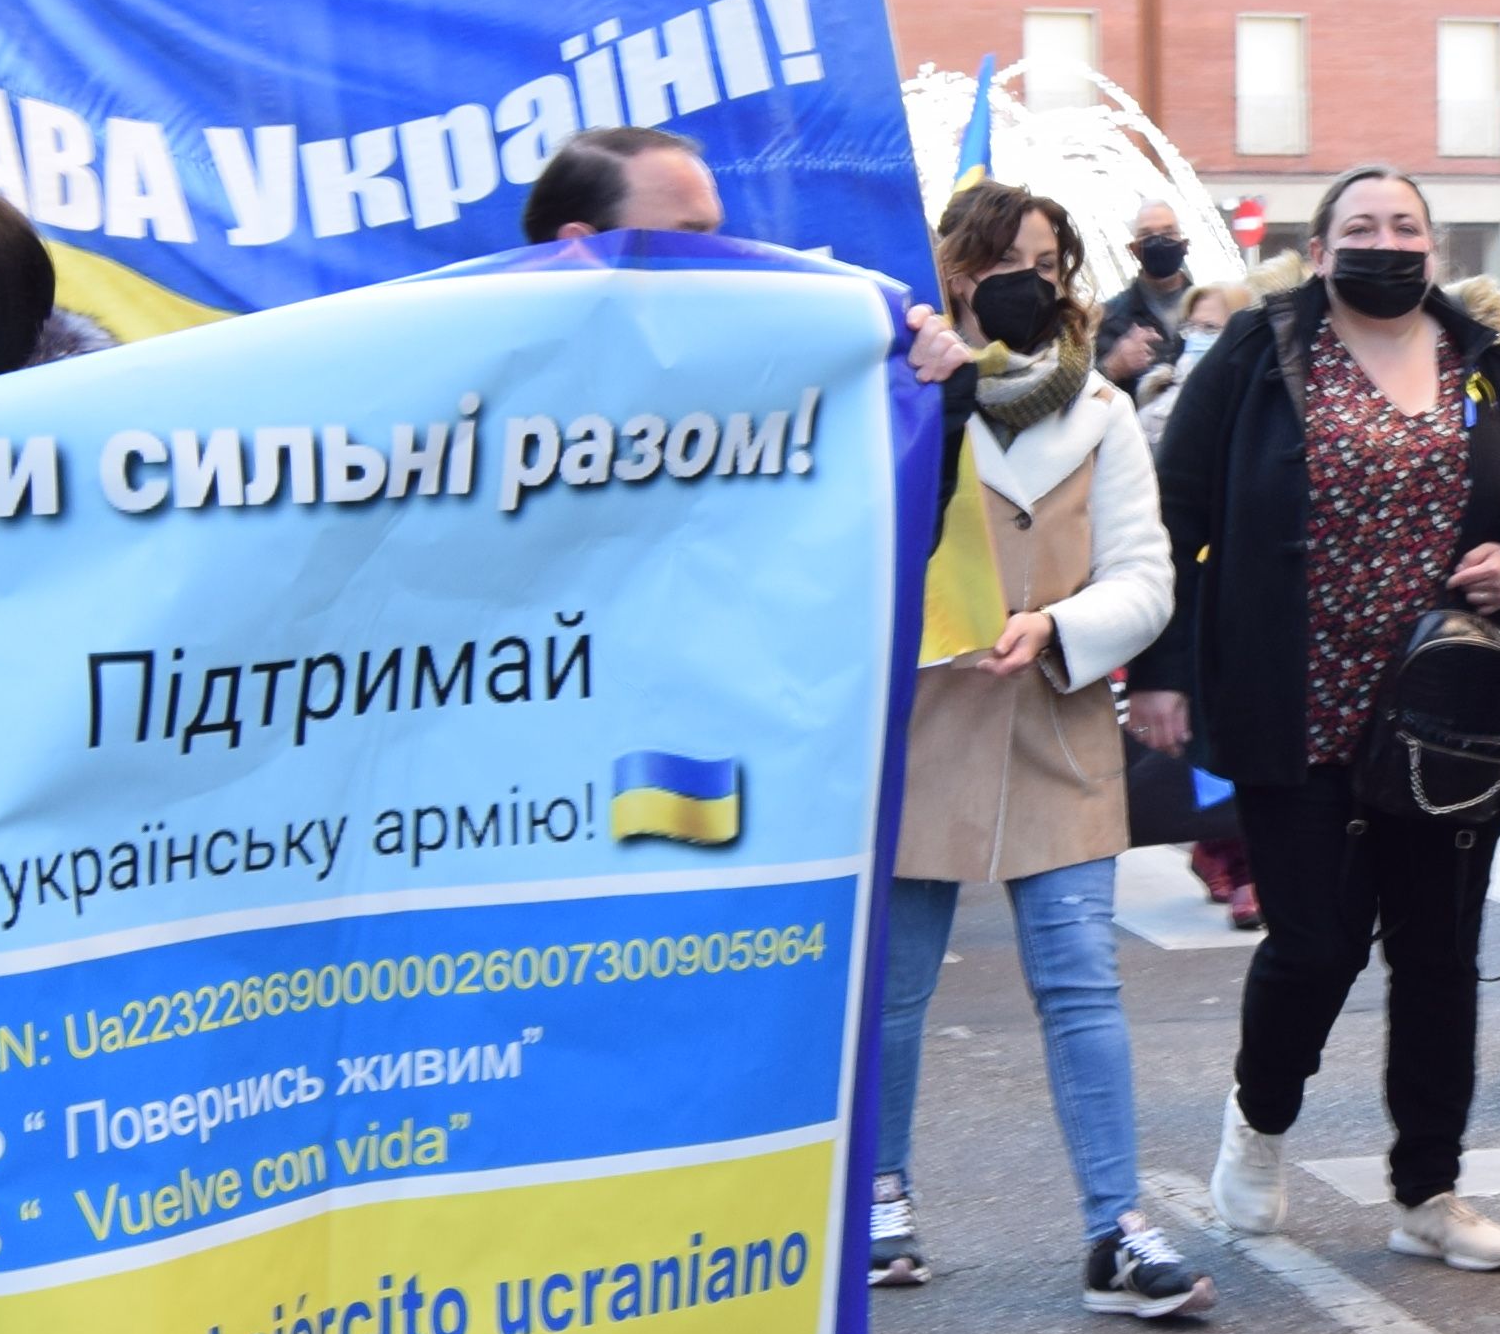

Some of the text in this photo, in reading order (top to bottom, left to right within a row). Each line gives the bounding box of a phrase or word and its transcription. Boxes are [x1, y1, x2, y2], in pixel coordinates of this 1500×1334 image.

[101, 393, 481, 515] сильні
[502, 388, 820, 511] разом!
[86, 612, 595, 752] Підтримай
[373, 781, 597, 867] армію!
[63, 922, 827, 1060] Ua223226690000026007300905964
[65, 1063, 324, 1160] Повернись
[76, 1167, 243, 1244] Vuelve
[252, 1140, 327, 1196] con
